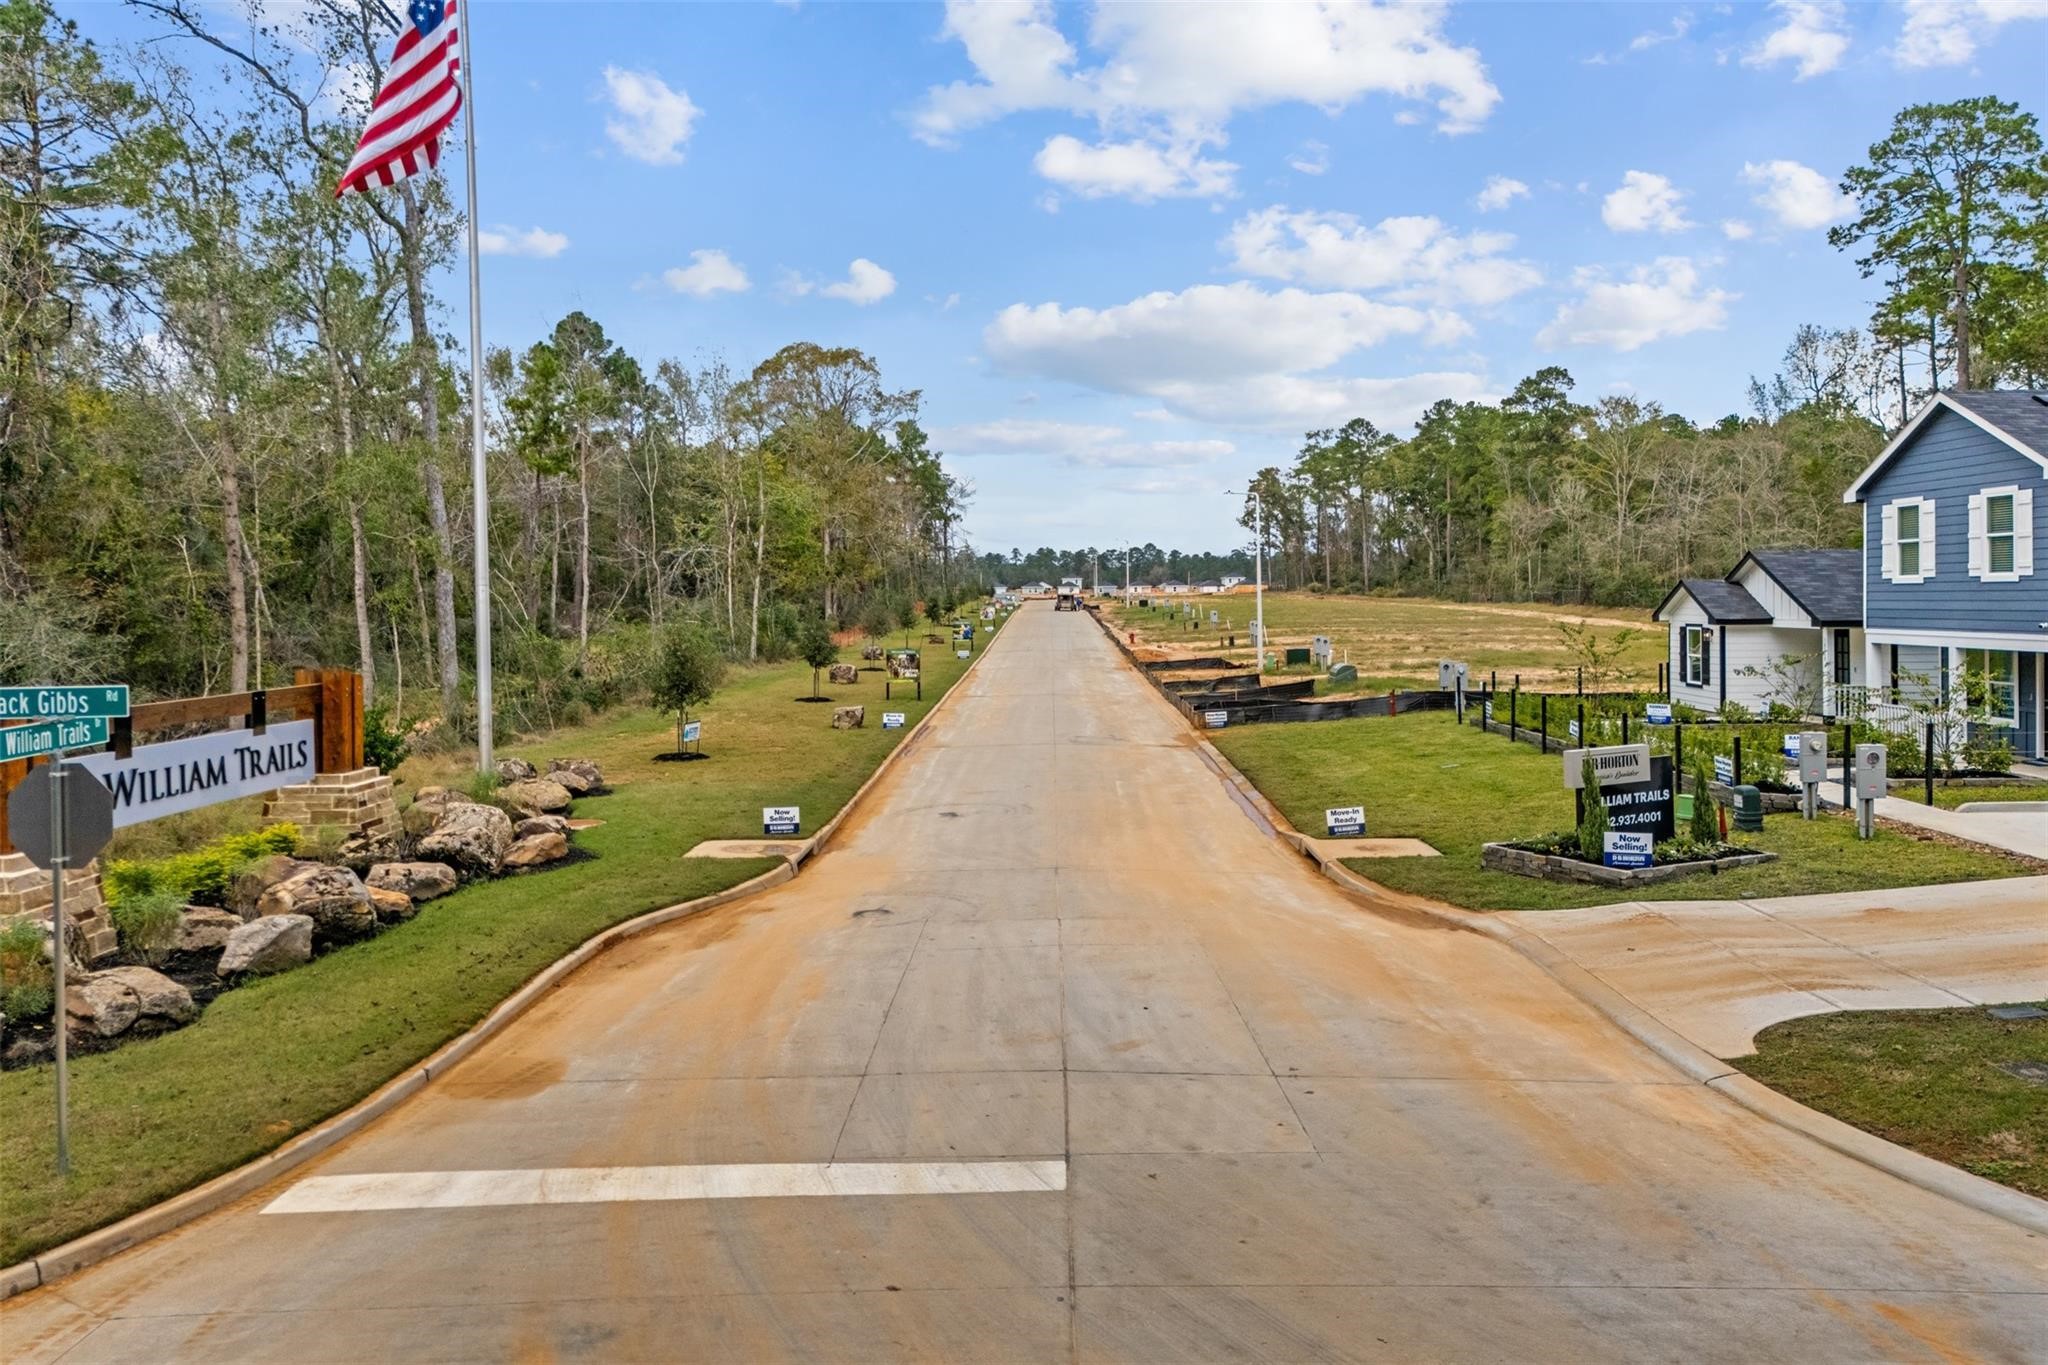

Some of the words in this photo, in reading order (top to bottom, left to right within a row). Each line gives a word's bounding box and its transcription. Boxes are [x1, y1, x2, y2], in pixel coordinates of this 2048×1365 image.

[0, 692, 30, 714] ack
[38, 690, 89, 714] Gibbs
[106, 690, 118, 702] Rd
[5, 729, 52, 755] William
[57, 721, 91, 746] Trails
[102, 755, 228, 810] WILLIAM
[234, 740, 308, 781] TRAILS
[1601, 793, 1632, 807] LLIAM
[1633, 789, 1670, 804] TRAILS
[1334, 816, 1358, 824] Ready
[1607, 811, 1661, 827] 2.937.4001
[1619, 834, 1641, 842] Now
[1612, 842, 1648, 852] Selling!
